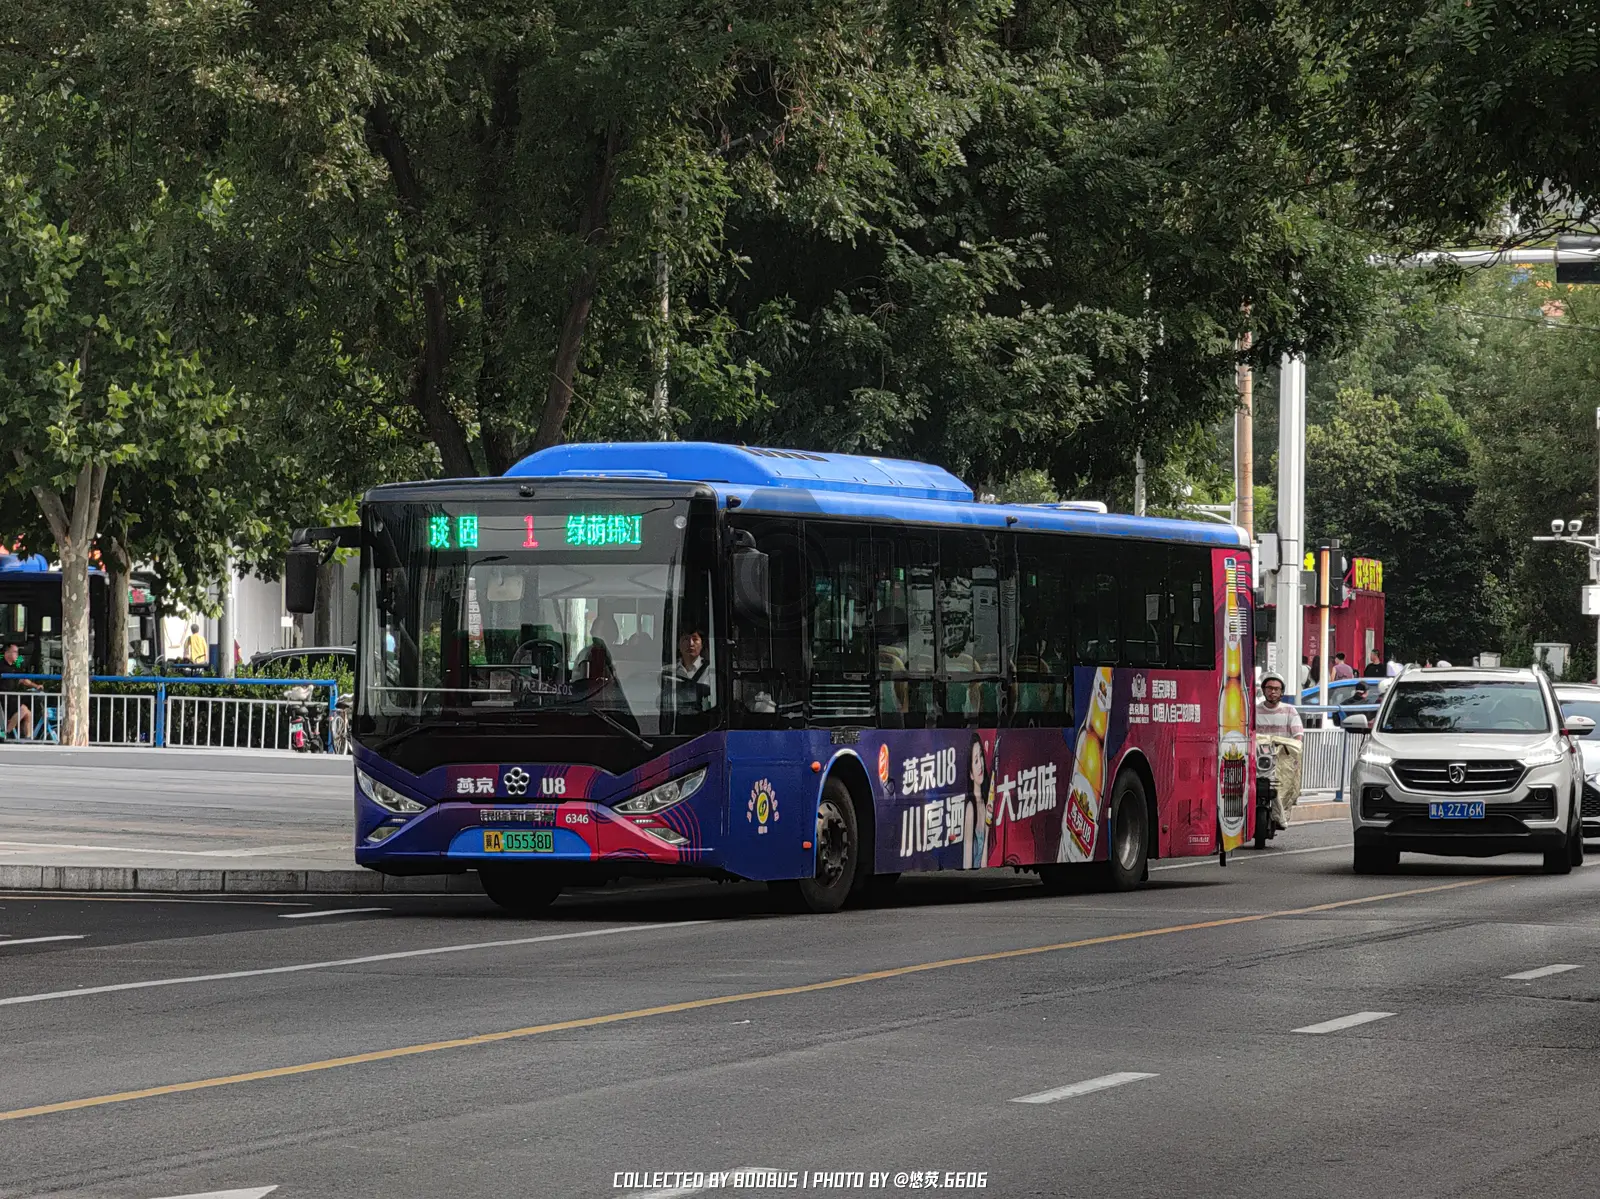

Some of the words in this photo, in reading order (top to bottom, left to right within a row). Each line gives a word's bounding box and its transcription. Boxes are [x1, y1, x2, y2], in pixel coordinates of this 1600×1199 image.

[429, 514, 479, 549] 谈固
[522, 515, 539, 548] 1
[566, 514, 643, 546] 绿荫锦江
[456, 777, 495, 794] 燕京
[542, 777, 566, 795] U8
[902, 746, 956, 796] 燕京U8
[995, 762, 1057, 826] 大滋味
[565, 813, 589, 824] 6346
[900, 793, 966, 857] 小度酒
